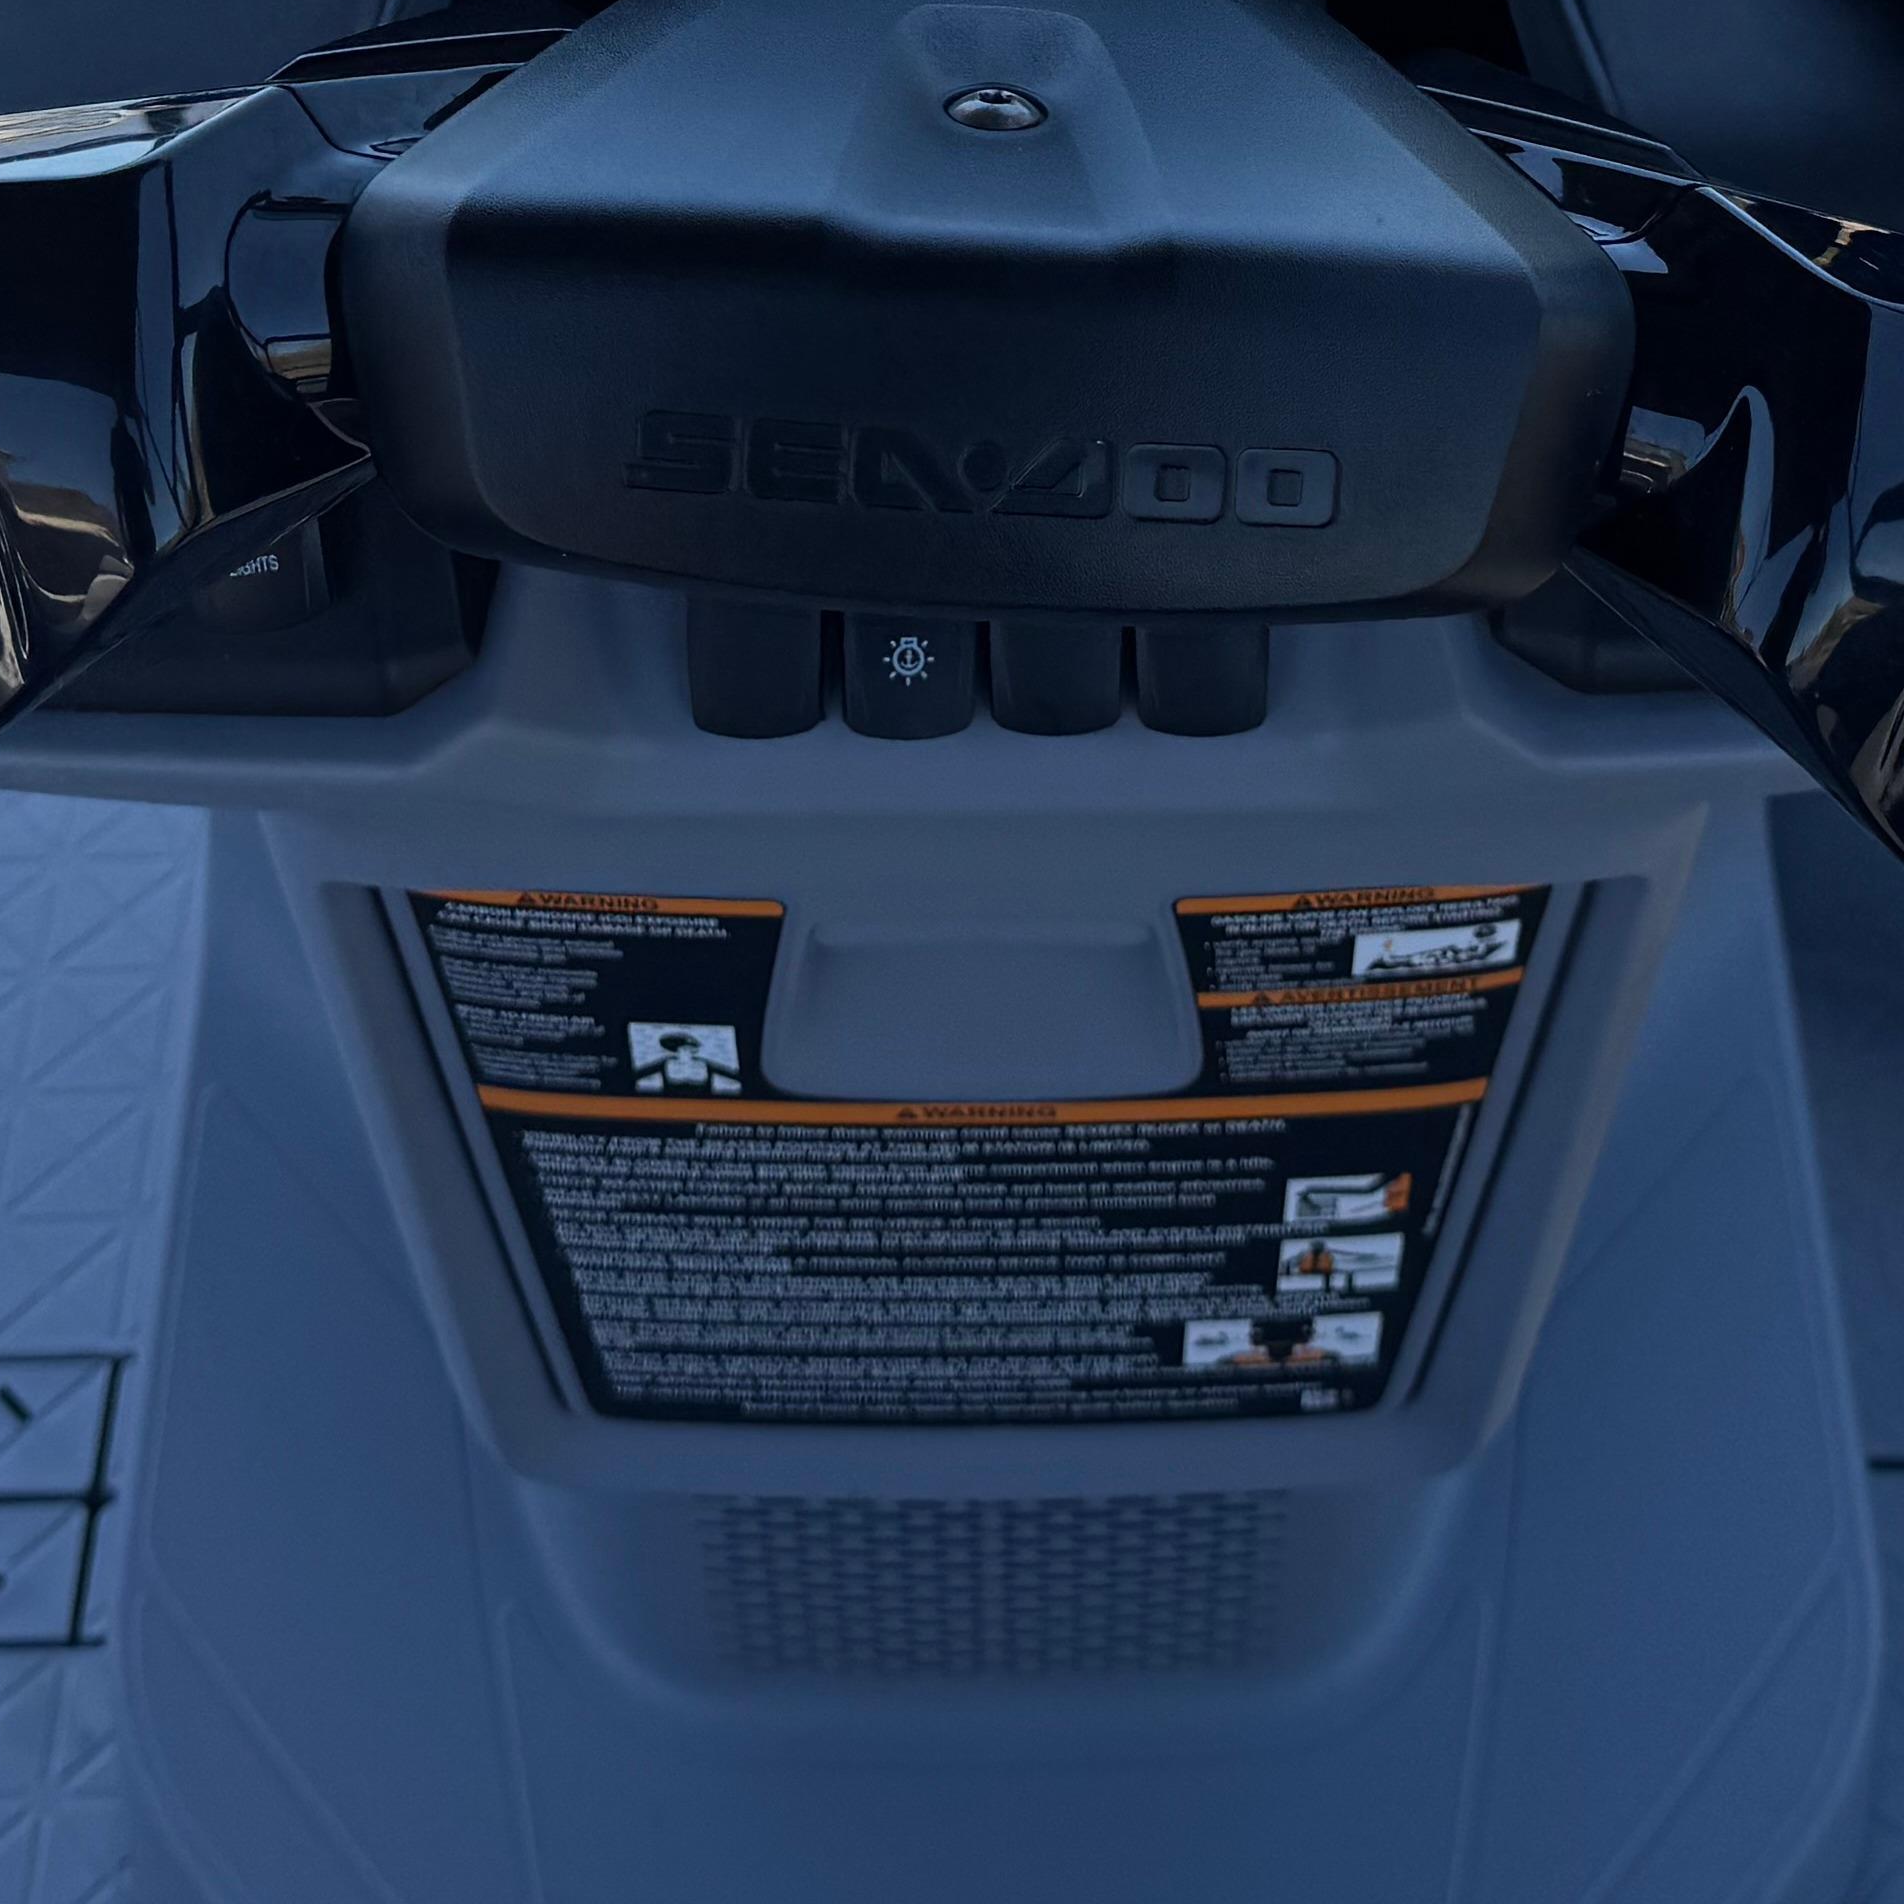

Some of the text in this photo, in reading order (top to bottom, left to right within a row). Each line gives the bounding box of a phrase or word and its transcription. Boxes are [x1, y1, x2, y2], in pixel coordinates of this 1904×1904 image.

[539, 892, 659, 910] WARNING
[1314, 887, 1435, 908] WARNING
[923, 1105, 1056, 1120] WARNING
